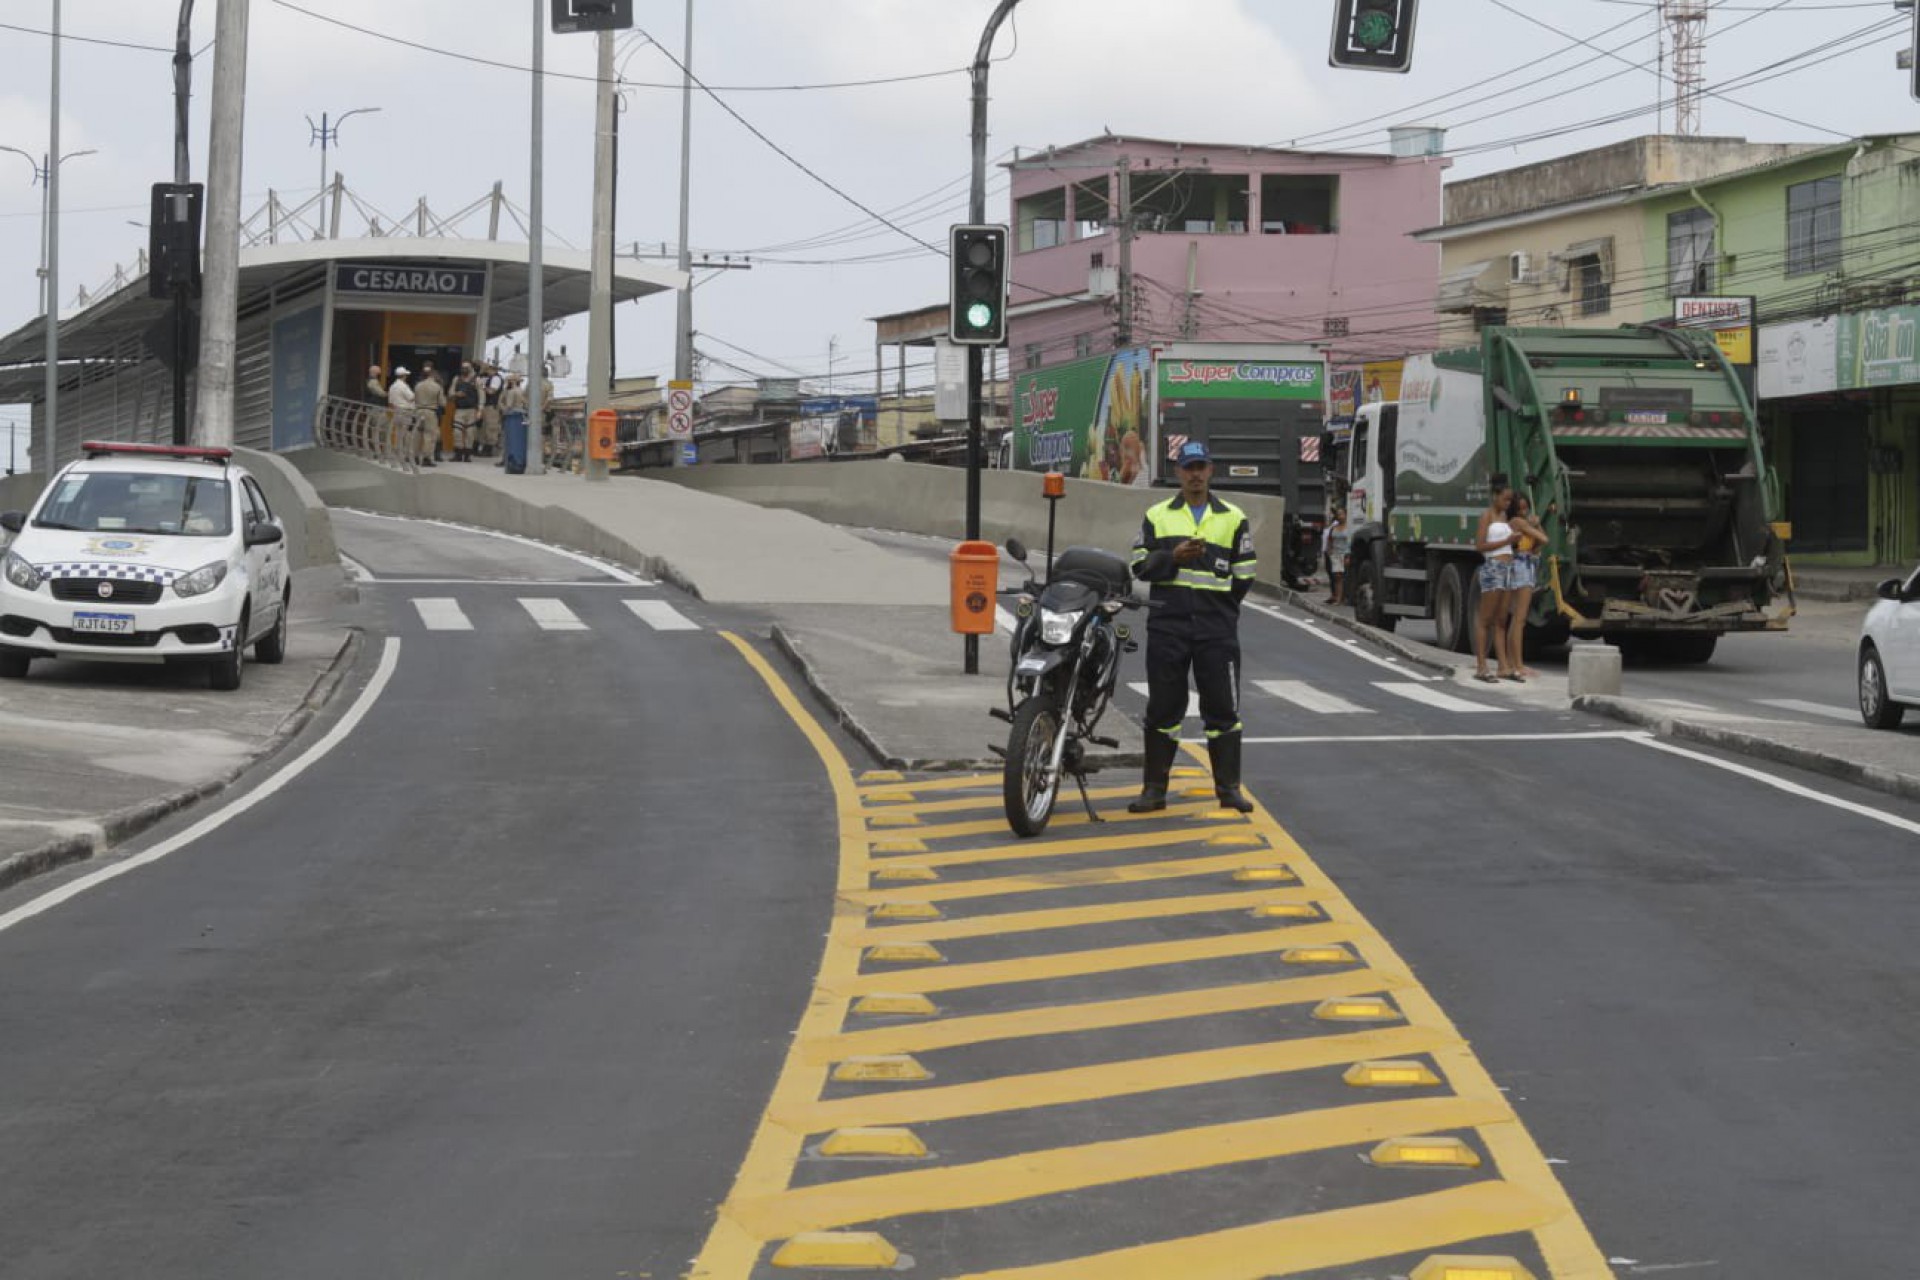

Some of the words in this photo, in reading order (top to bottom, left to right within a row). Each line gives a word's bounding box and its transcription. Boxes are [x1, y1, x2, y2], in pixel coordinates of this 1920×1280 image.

[353, 269, 456, 292] CESARÃO
[462, 274, 468, 293] I
[1683, 301, 1739, 318] DENTISTA
[1170, 360, 1233, 385] Super
[1236, 360, 1316, 386] Compras
[1022, 378, 1058, 430] Super
[1030, 422, 1073, 465] Compras
